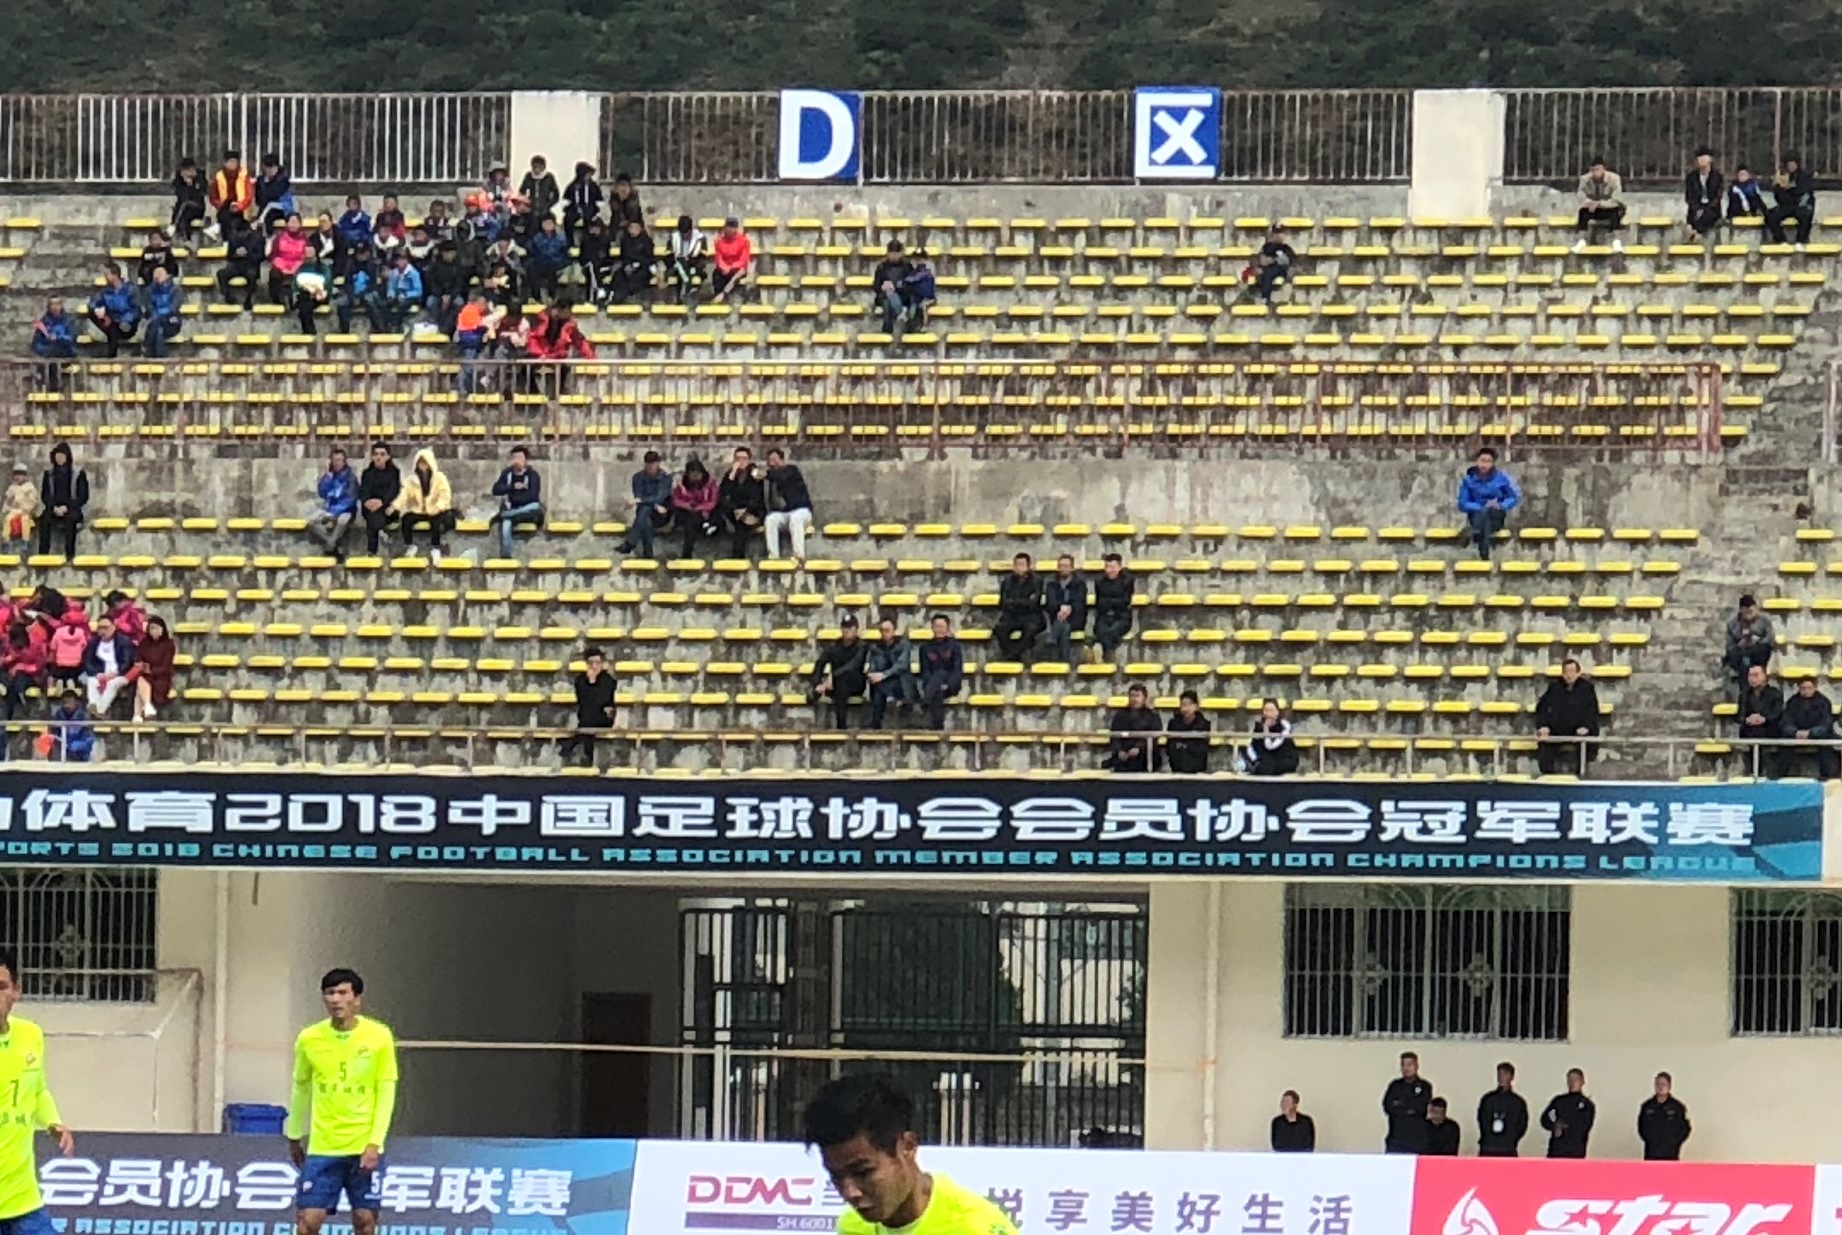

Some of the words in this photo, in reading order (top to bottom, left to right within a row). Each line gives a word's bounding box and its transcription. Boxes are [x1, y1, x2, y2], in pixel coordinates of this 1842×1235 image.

[779, 89, 855, 179] D
[1135, 91, 1216, 178] 区
[212, 843, 378, 860] CHINESE
[390, 845, 590, 862] FOOTBALL
[602, 847, 861, 864] ASSOCIATION
[875, 849, 1058, 866] MEMBER
[1071, 851, 1335, 867] ASSOCIATION
[1346, 852, 1587, 869] CHAMPIONS
[1599, 854, 1756, 870] LEAGUE
[339, 1061, 347, 1083] 5
[10, 1079, 19, 1107] 7
[371, 1171, 380, 1195] 5
[687, 1175, 815, 1205] DDMC
